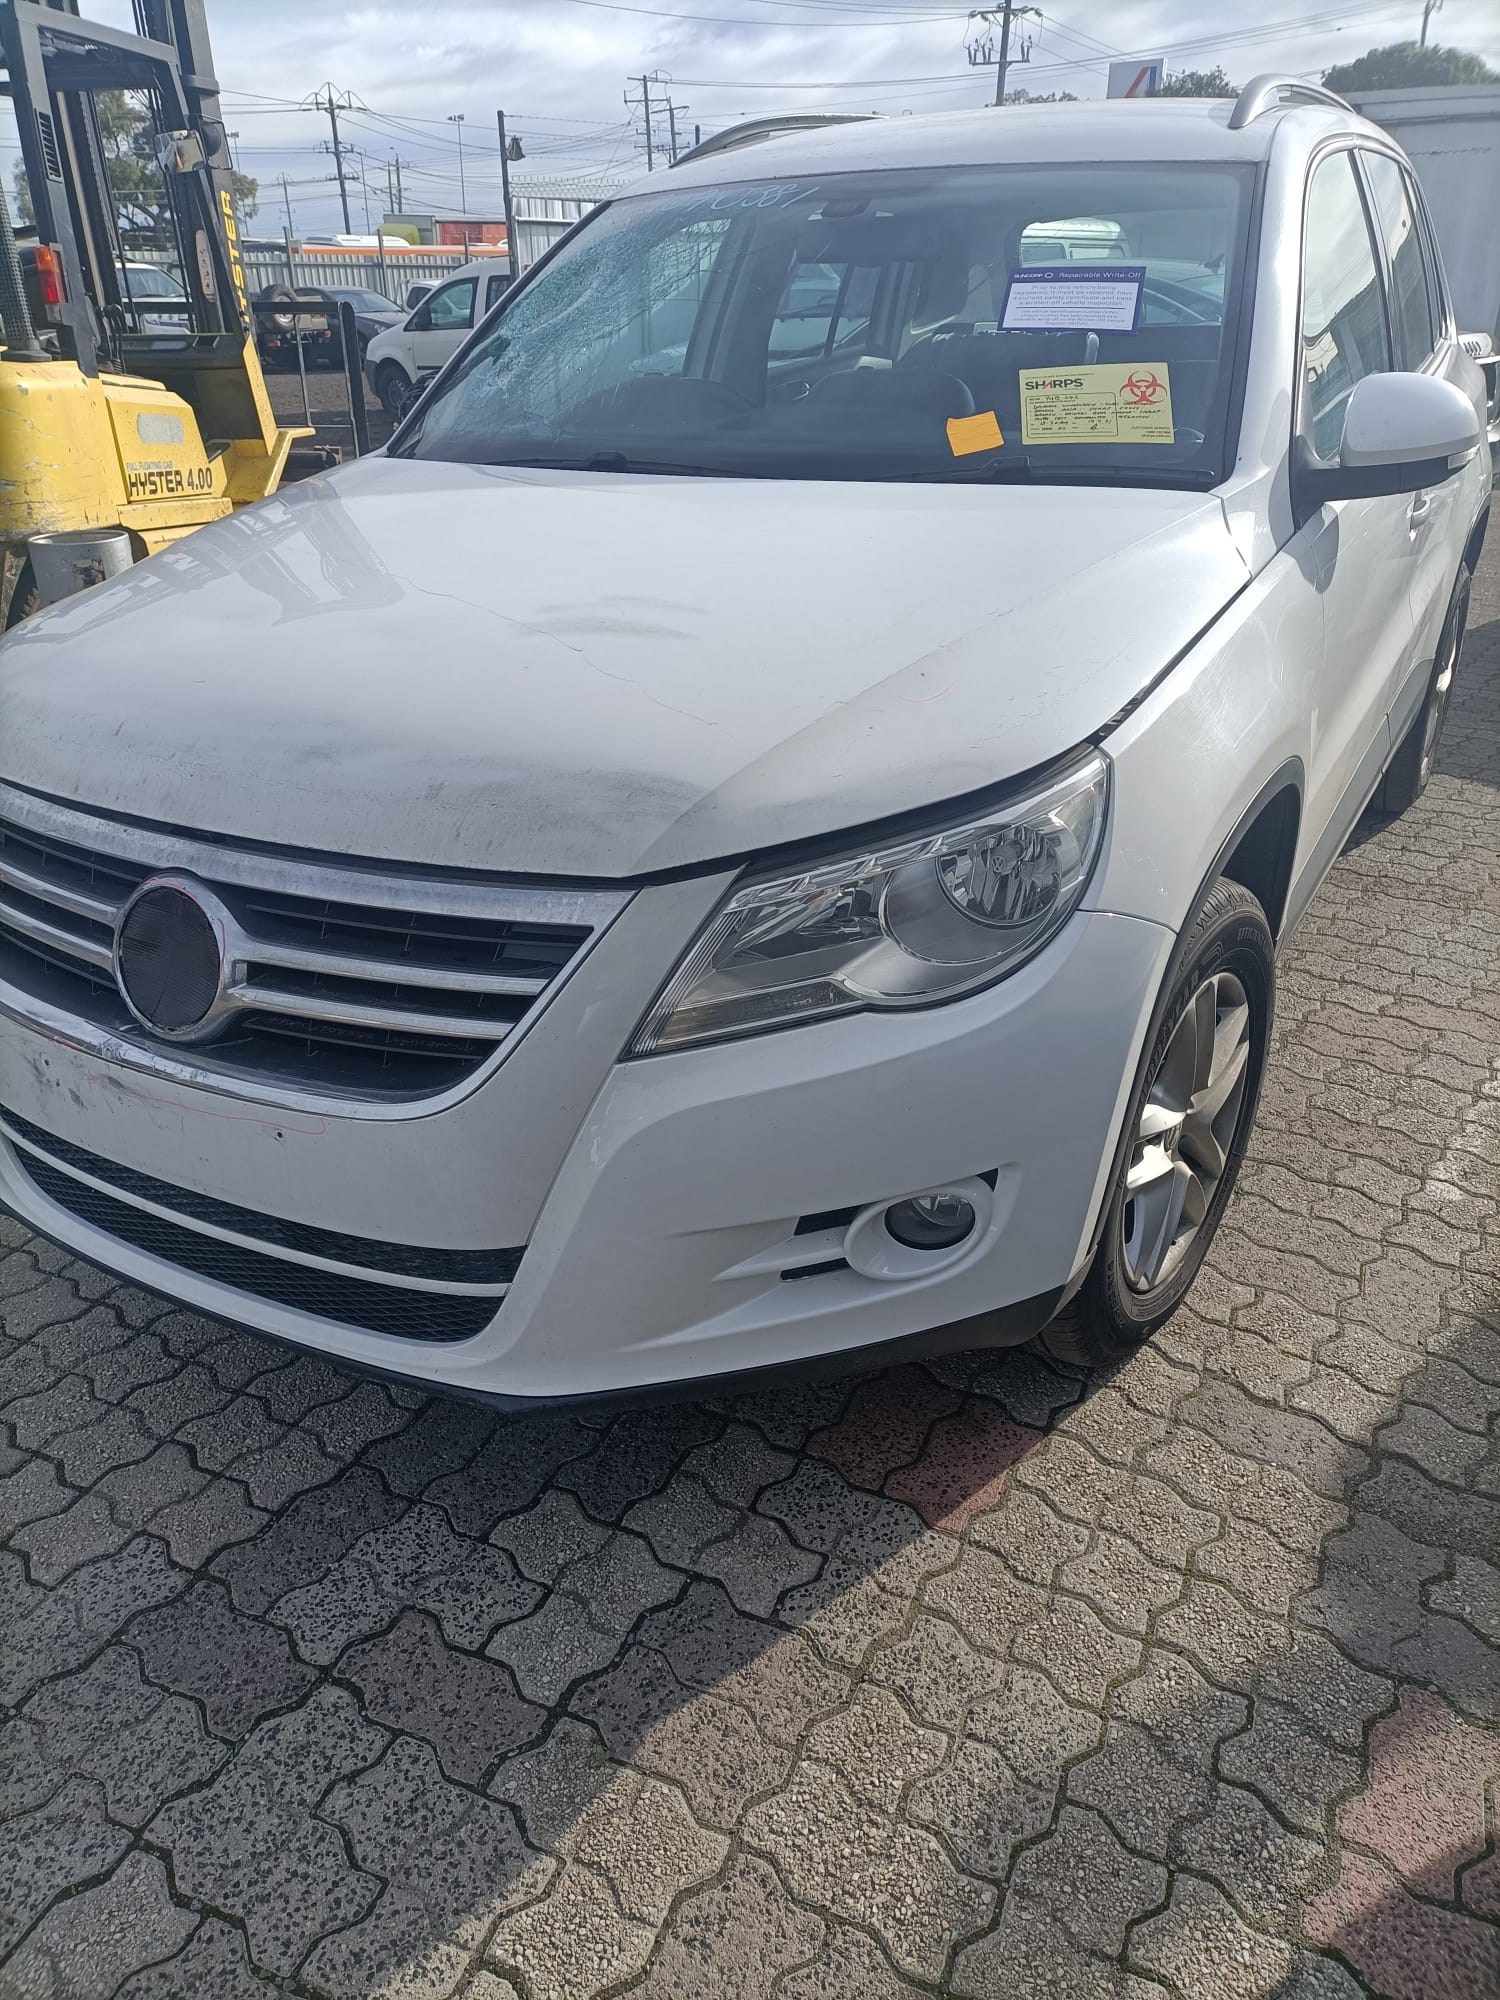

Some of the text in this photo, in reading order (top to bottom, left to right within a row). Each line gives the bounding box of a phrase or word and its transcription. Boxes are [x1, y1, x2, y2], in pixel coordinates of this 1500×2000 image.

[1058, 271, 1100, 280] Repairable
[1103, 271, 1141, 279] Write-Off
[1026, 377, 1084, 391] SHARPS
[128, 467, 213, 497] HYSTER 4.00
